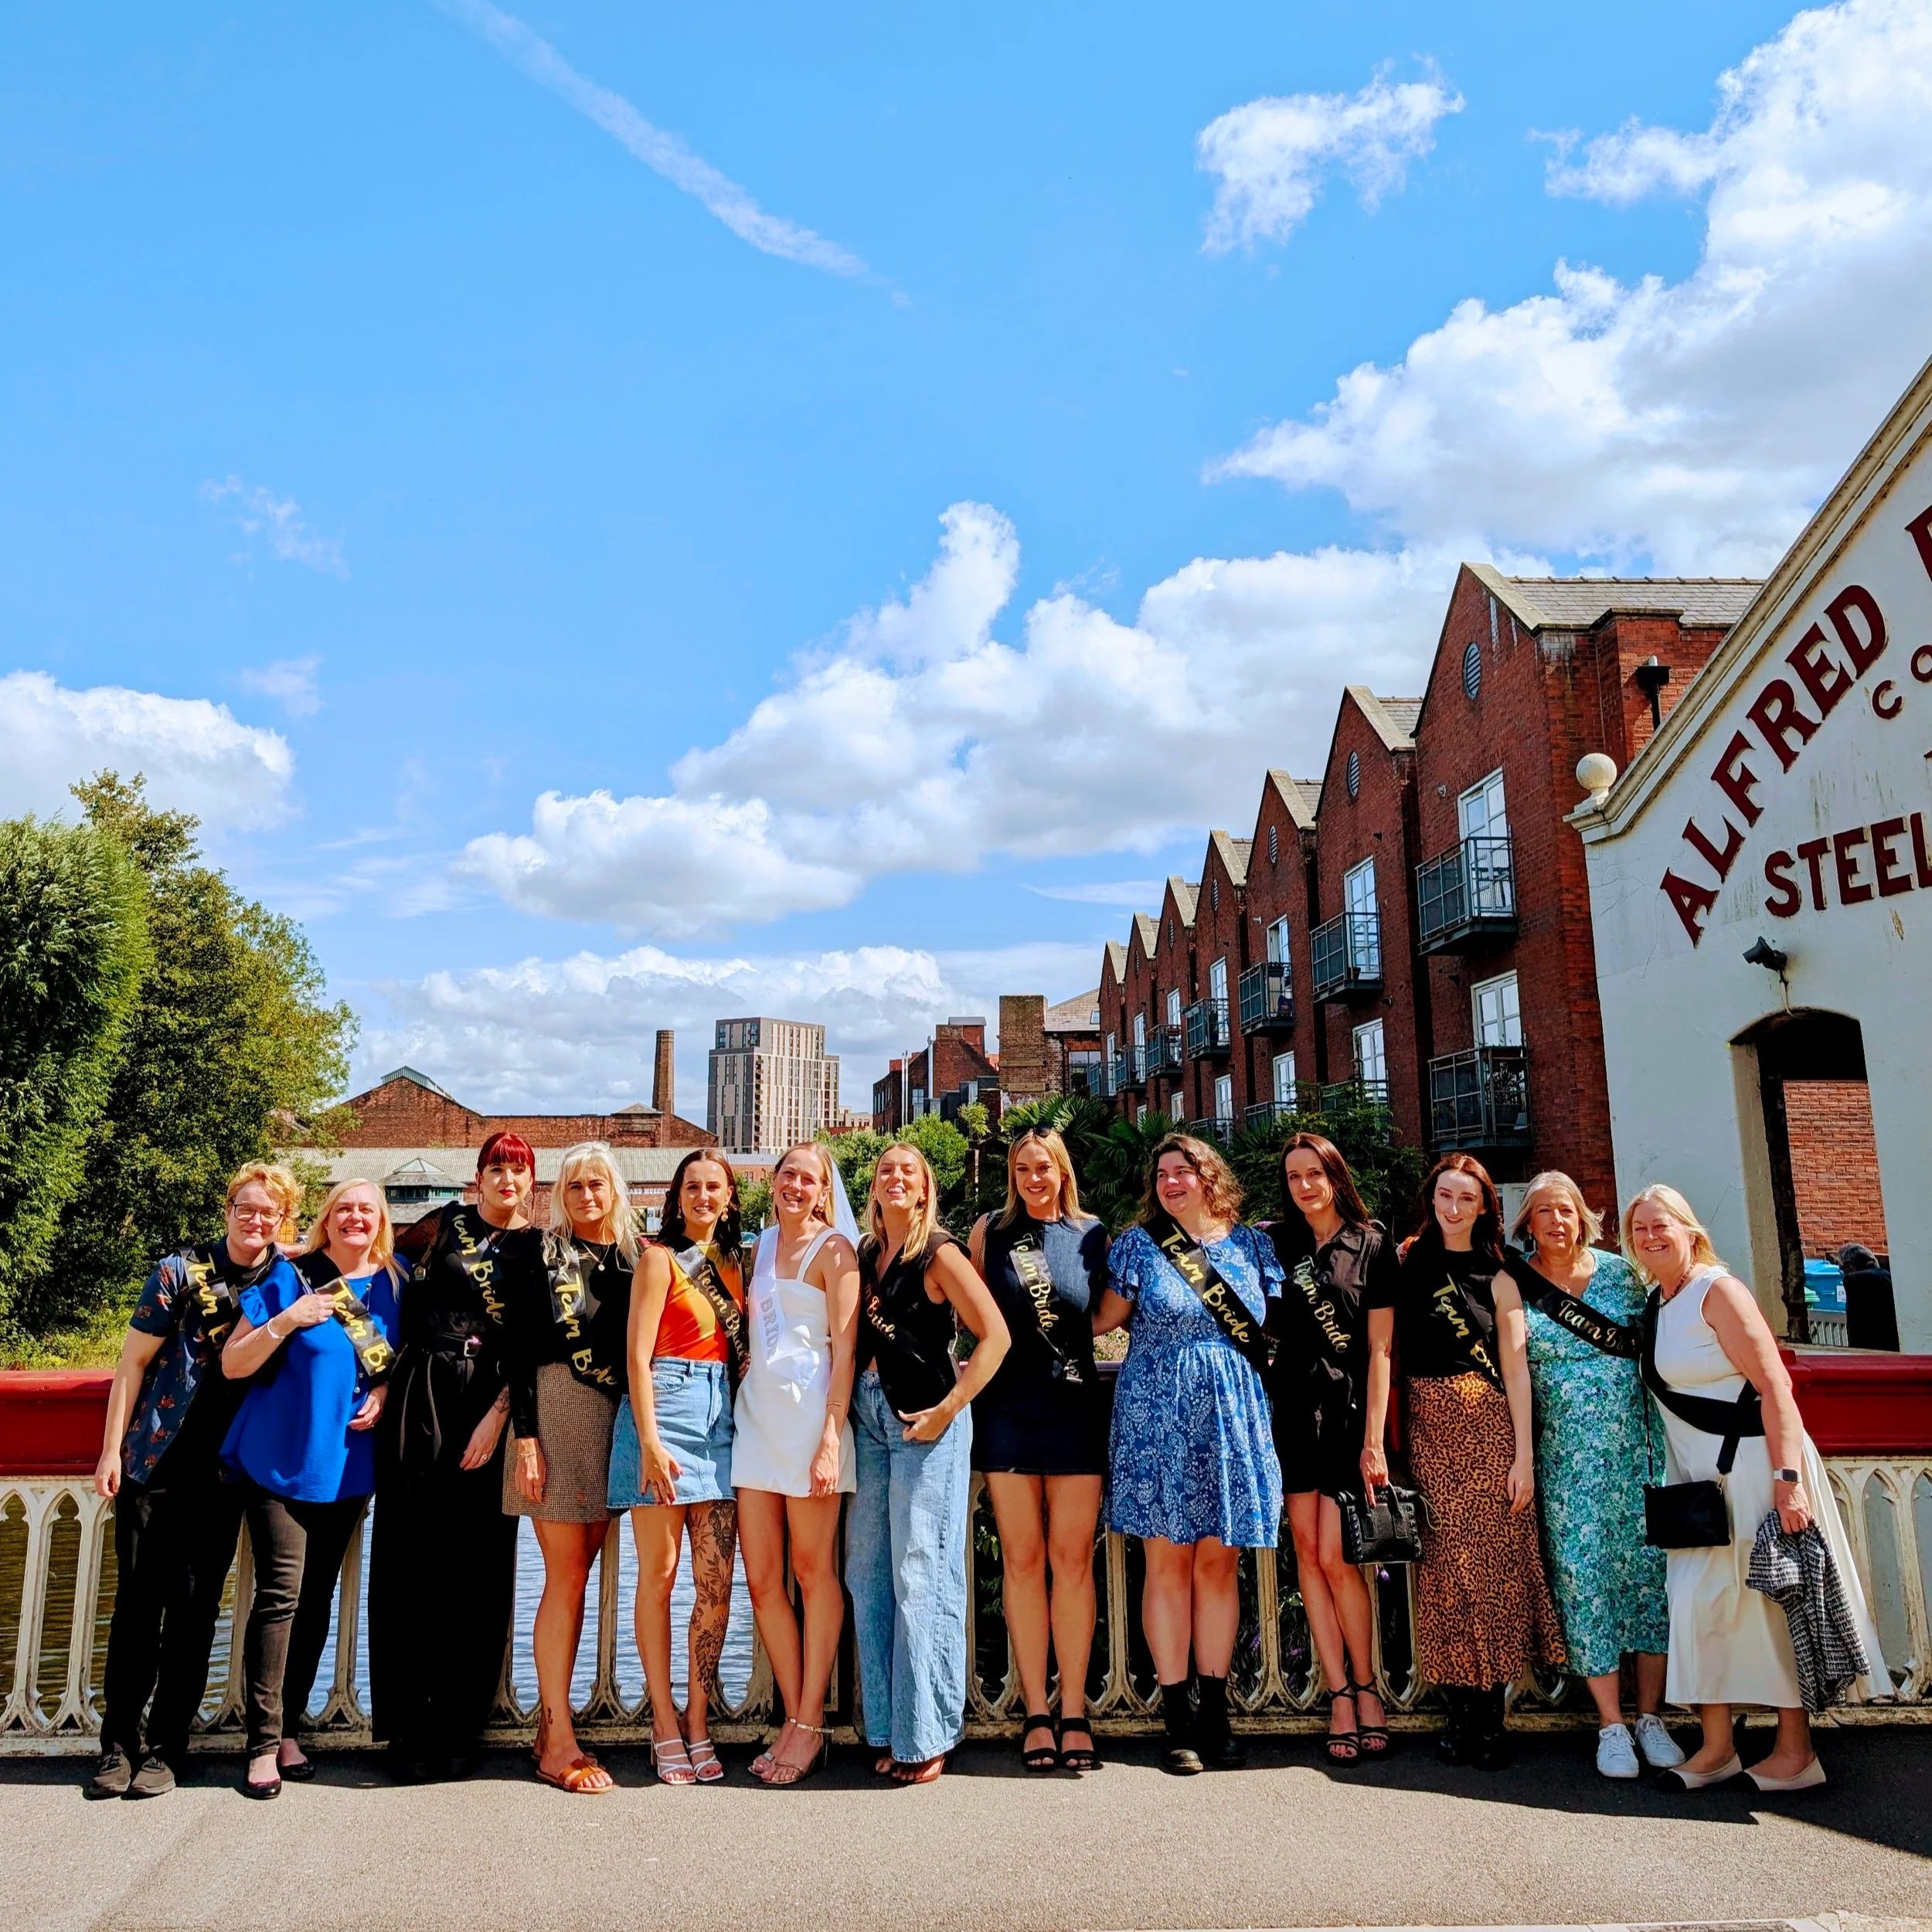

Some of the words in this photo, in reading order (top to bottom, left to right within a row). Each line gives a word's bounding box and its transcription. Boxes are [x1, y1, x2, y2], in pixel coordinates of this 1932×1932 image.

[1659, 584, 1888, 949] ALFRED
[1764, 812, 1932, 918] STEEL
[188, 1252, 218, 1317] Team
[332, 1277, 367, 1341] Team
[470, 1260, 505, 1325] Bride
[554, 1272, 582, 1340] Team
[697, 1264, 727, 1314] Team
[1014, 1233, 1038, 1280] Team
[1029, 1278, 1060, 1332] Bride
[1162, 1223, 1203, 1284] Team
[1202, 1281, 1250, 1343] Bride
[1433, 1272, 1470, 1340] Team
[1314, 1301, 1351, 1353] Bride
[1558, 1299, 1602, 1341] Team
